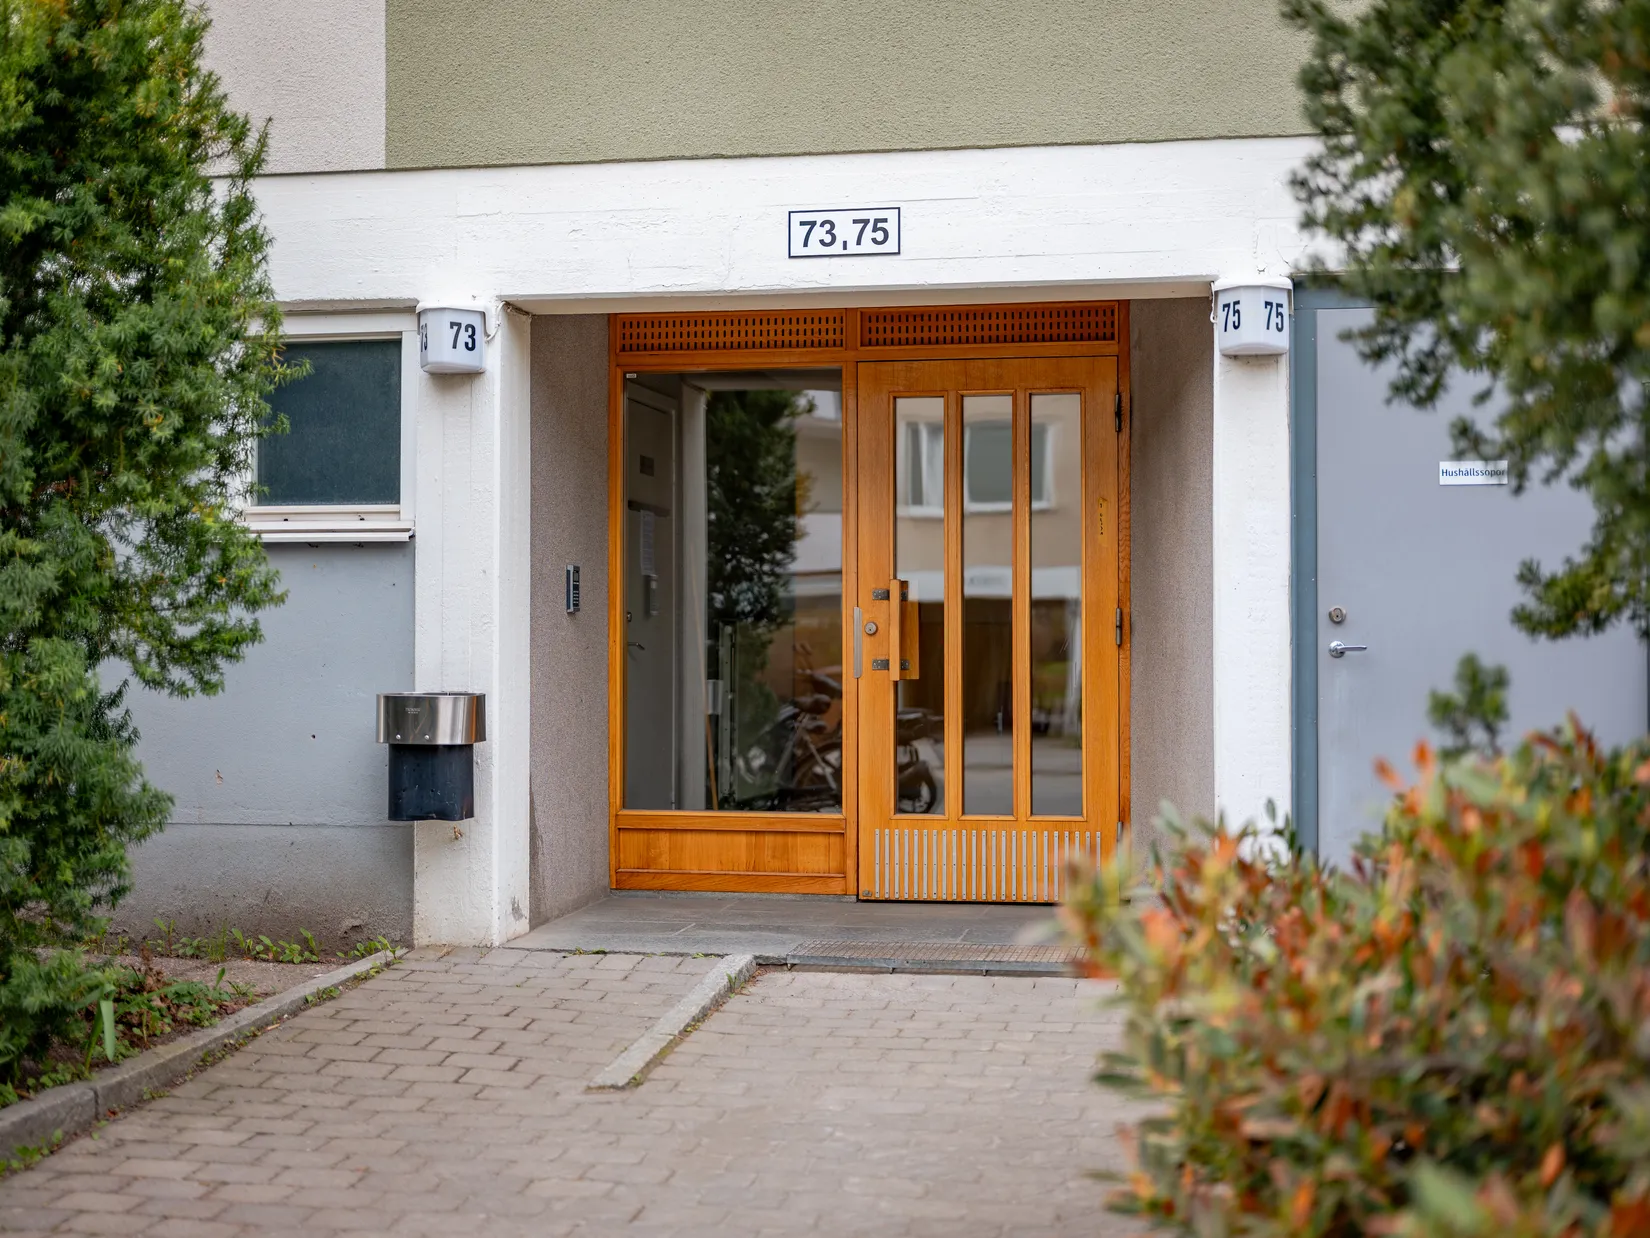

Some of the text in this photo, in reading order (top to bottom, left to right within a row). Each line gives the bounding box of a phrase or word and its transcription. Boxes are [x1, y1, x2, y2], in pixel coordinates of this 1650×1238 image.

[1222, 299, 1241, 333] 75
[1264, 300, 1284, 333] 75
[420, 322, 428, 353] 73
[449, 321, 476, 352] 73
[1441, 467, 1506, 478] Hushållssopor
